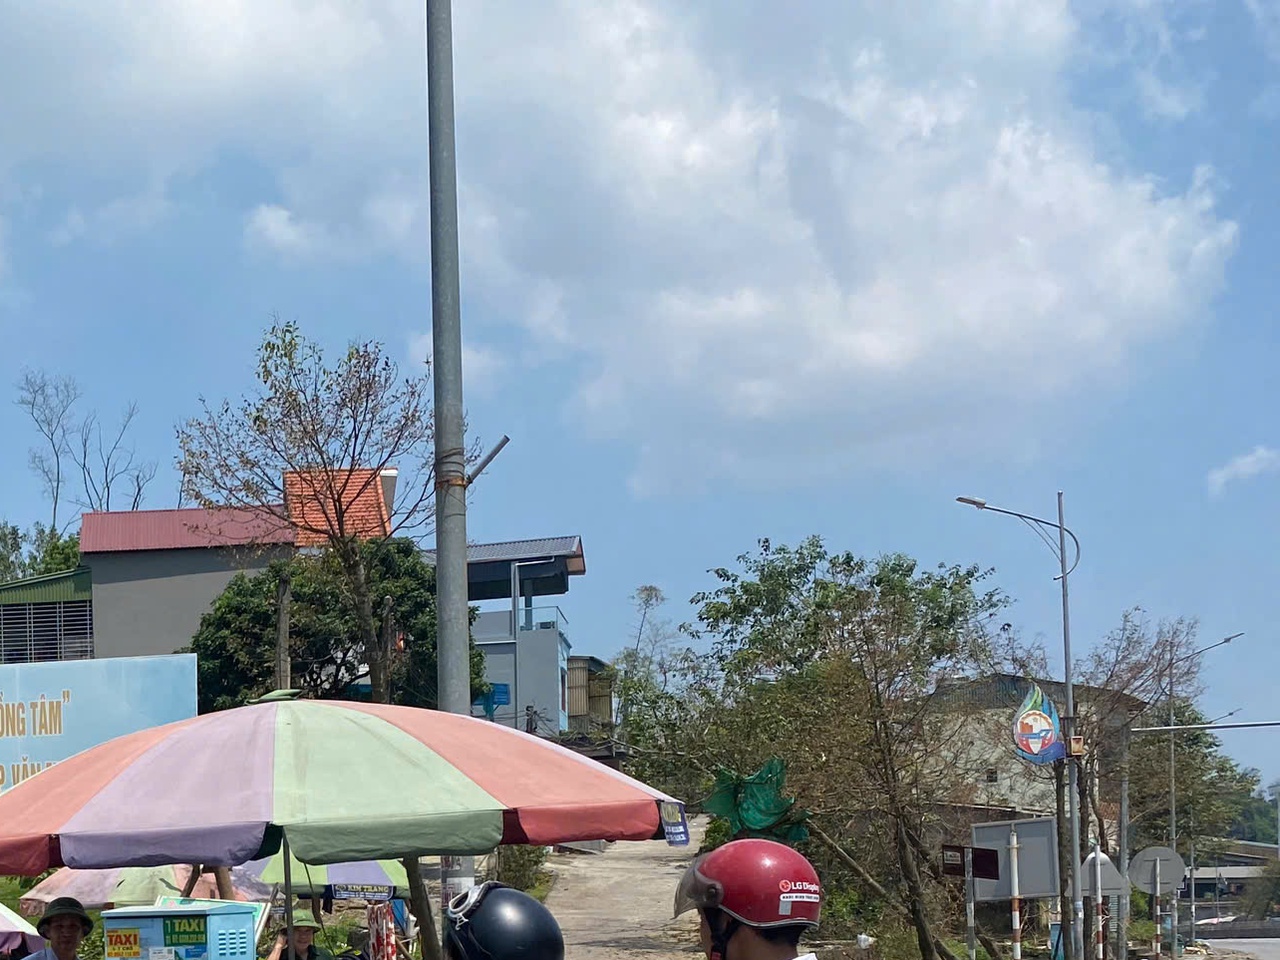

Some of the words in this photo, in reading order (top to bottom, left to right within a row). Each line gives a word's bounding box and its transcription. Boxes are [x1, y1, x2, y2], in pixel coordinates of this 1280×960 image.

[792, 881, 802, 890] LG
[174, 918, 204, 932] TAXI
[106, 933, 138, 946] TAXI
